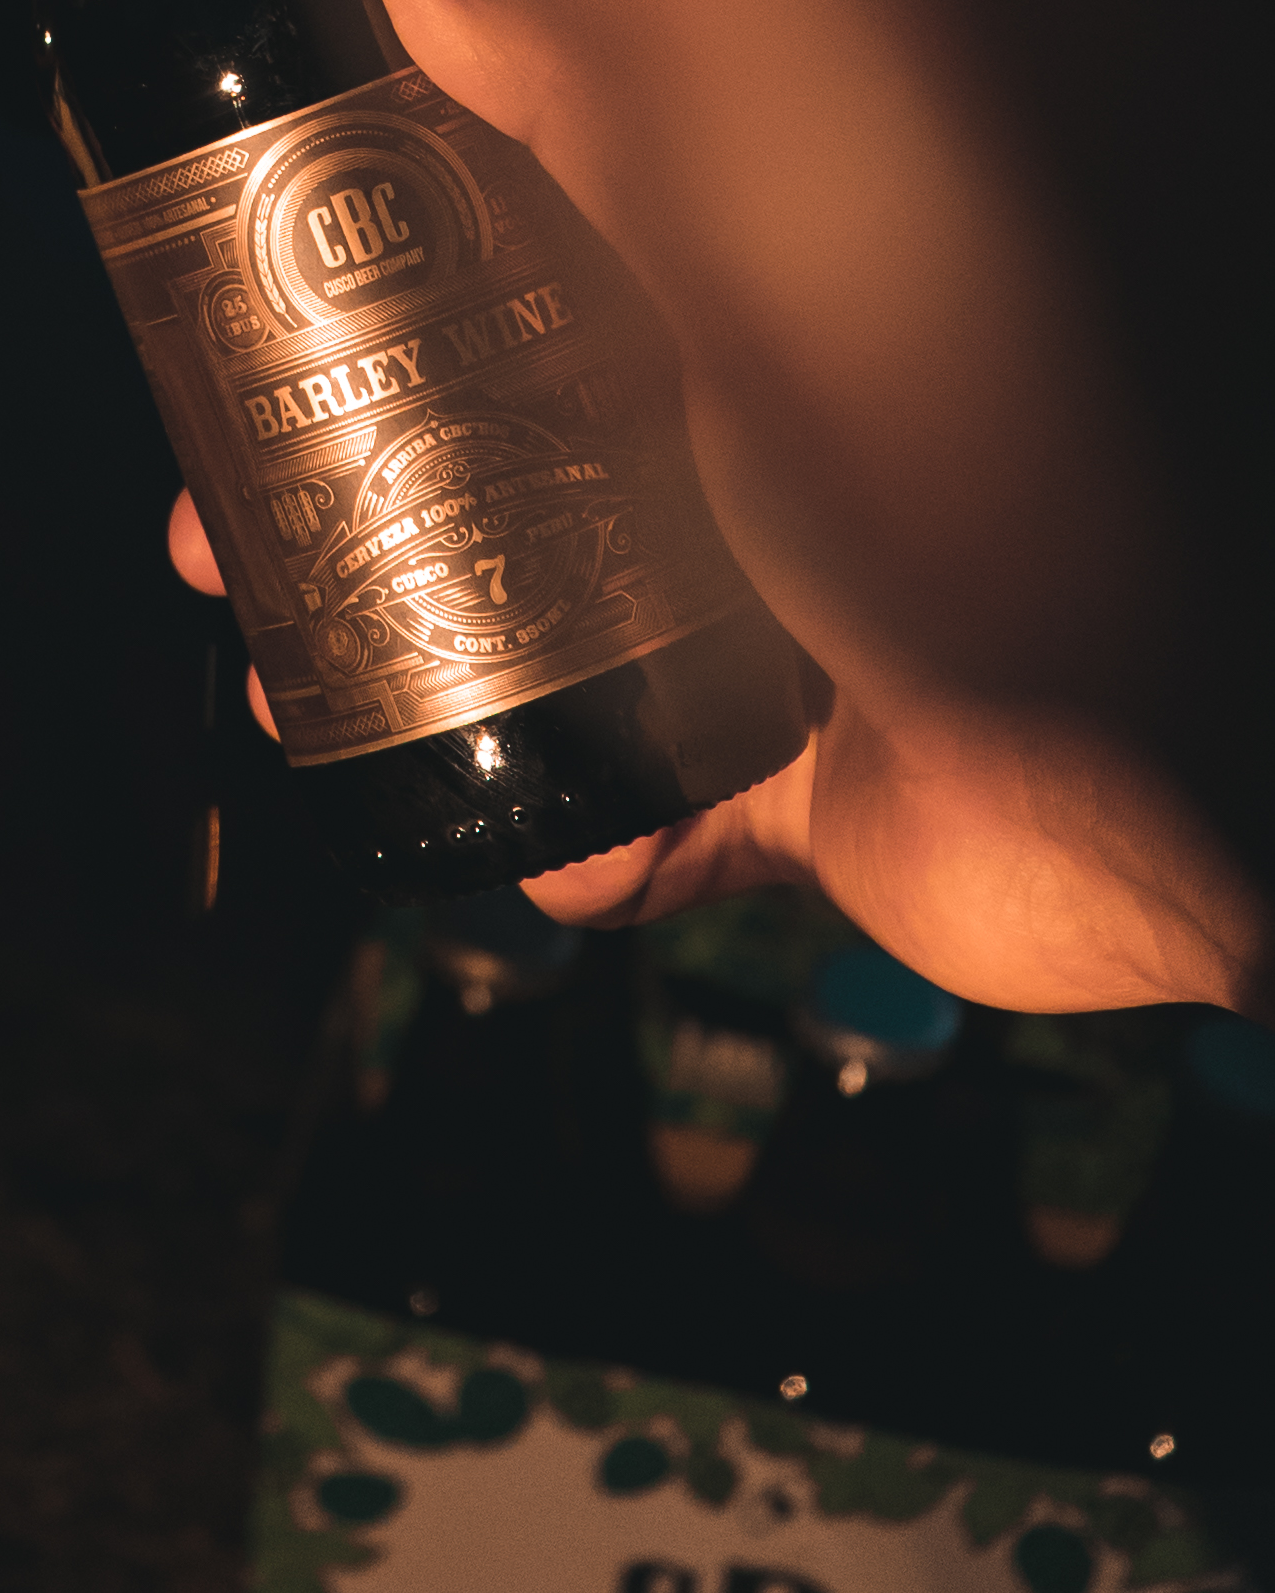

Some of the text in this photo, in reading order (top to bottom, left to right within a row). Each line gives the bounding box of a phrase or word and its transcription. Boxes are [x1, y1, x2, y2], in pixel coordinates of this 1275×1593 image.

[307, 181, 411, 269] CBC
[323, 245, 426, 299] CUSCO BEER COMPANY
[242, 281, 574, 442] BARLEY WINE
[381, 431, 439, 485] ARRIBA
[336, 463, 611, 579] CERVEZA 100% ARTESANAL
[390, 562, 450, 594] CUSCO
[474, 554, 508, 606] 7
[453, 634, 514, 654] CONT.
